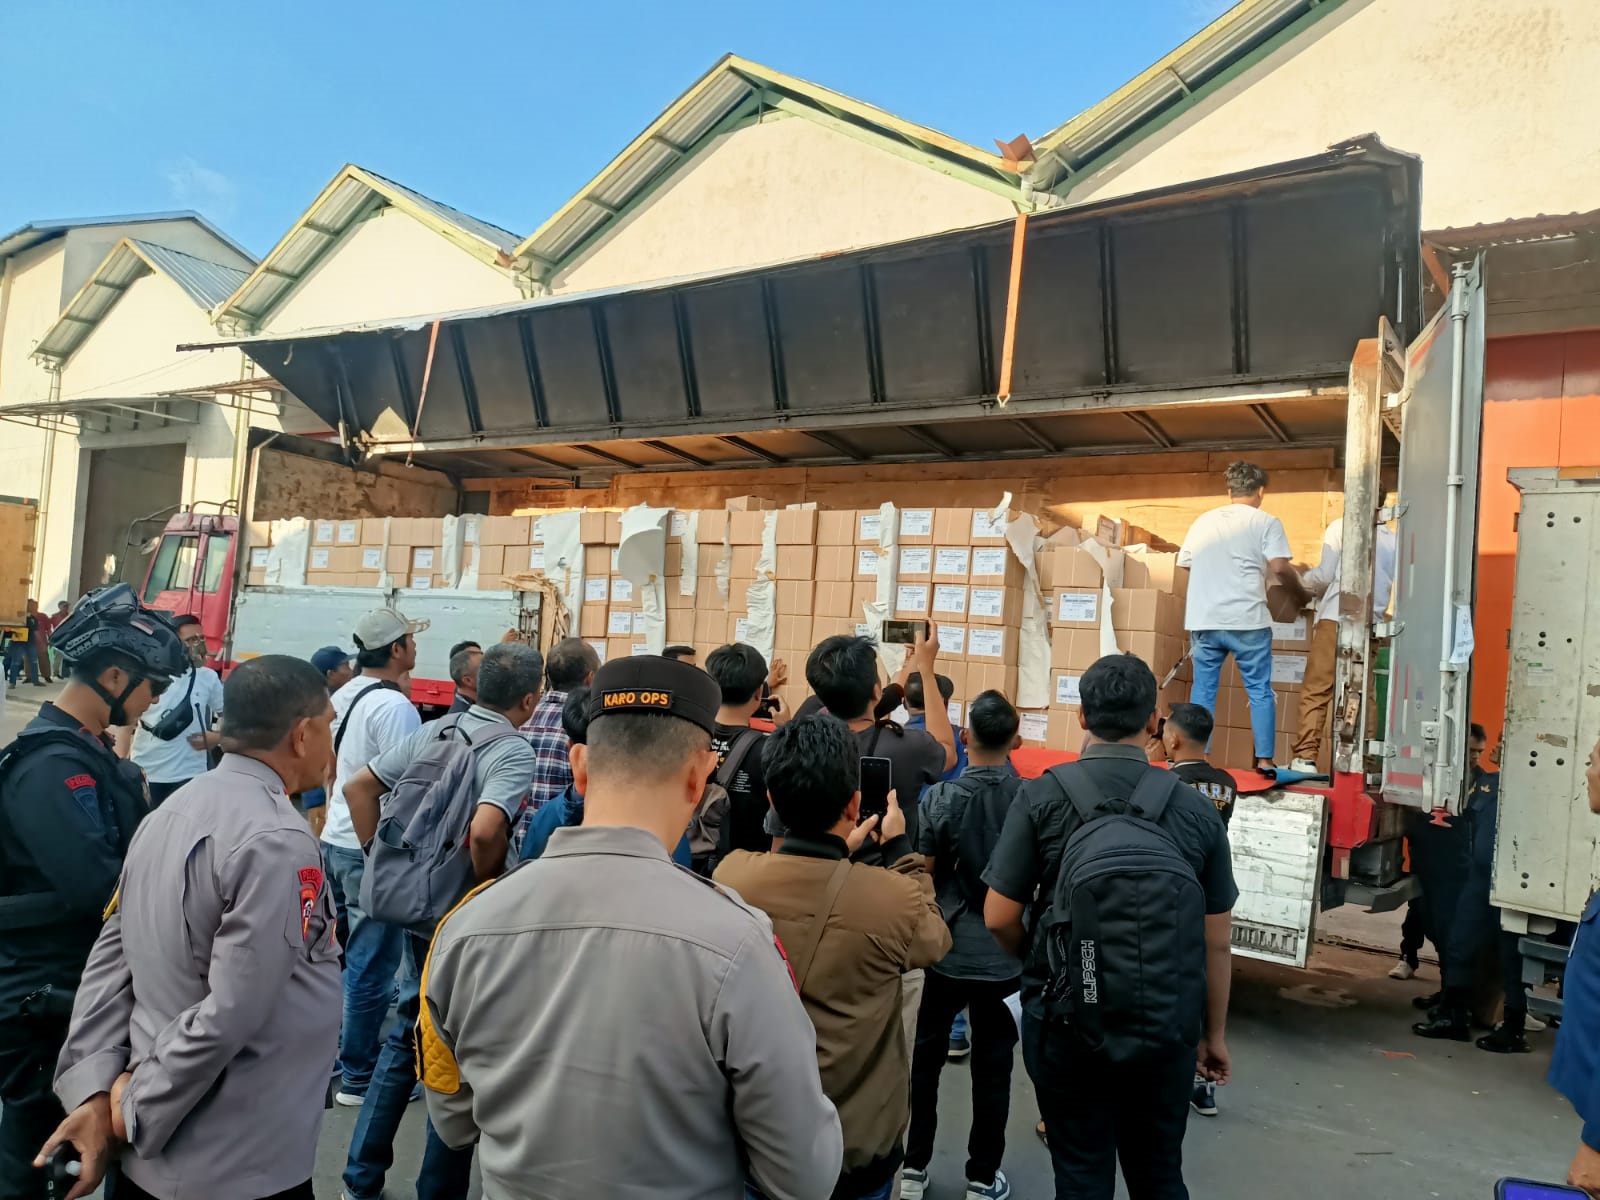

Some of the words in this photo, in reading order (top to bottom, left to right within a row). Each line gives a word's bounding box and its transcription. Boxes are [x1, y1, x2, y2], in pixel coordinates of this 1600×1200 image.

[604, 692, 635, 706] KARO
[641, 692, 668, 705] OPS
[1081, 940, 1098, 1004] KLIPSCH
